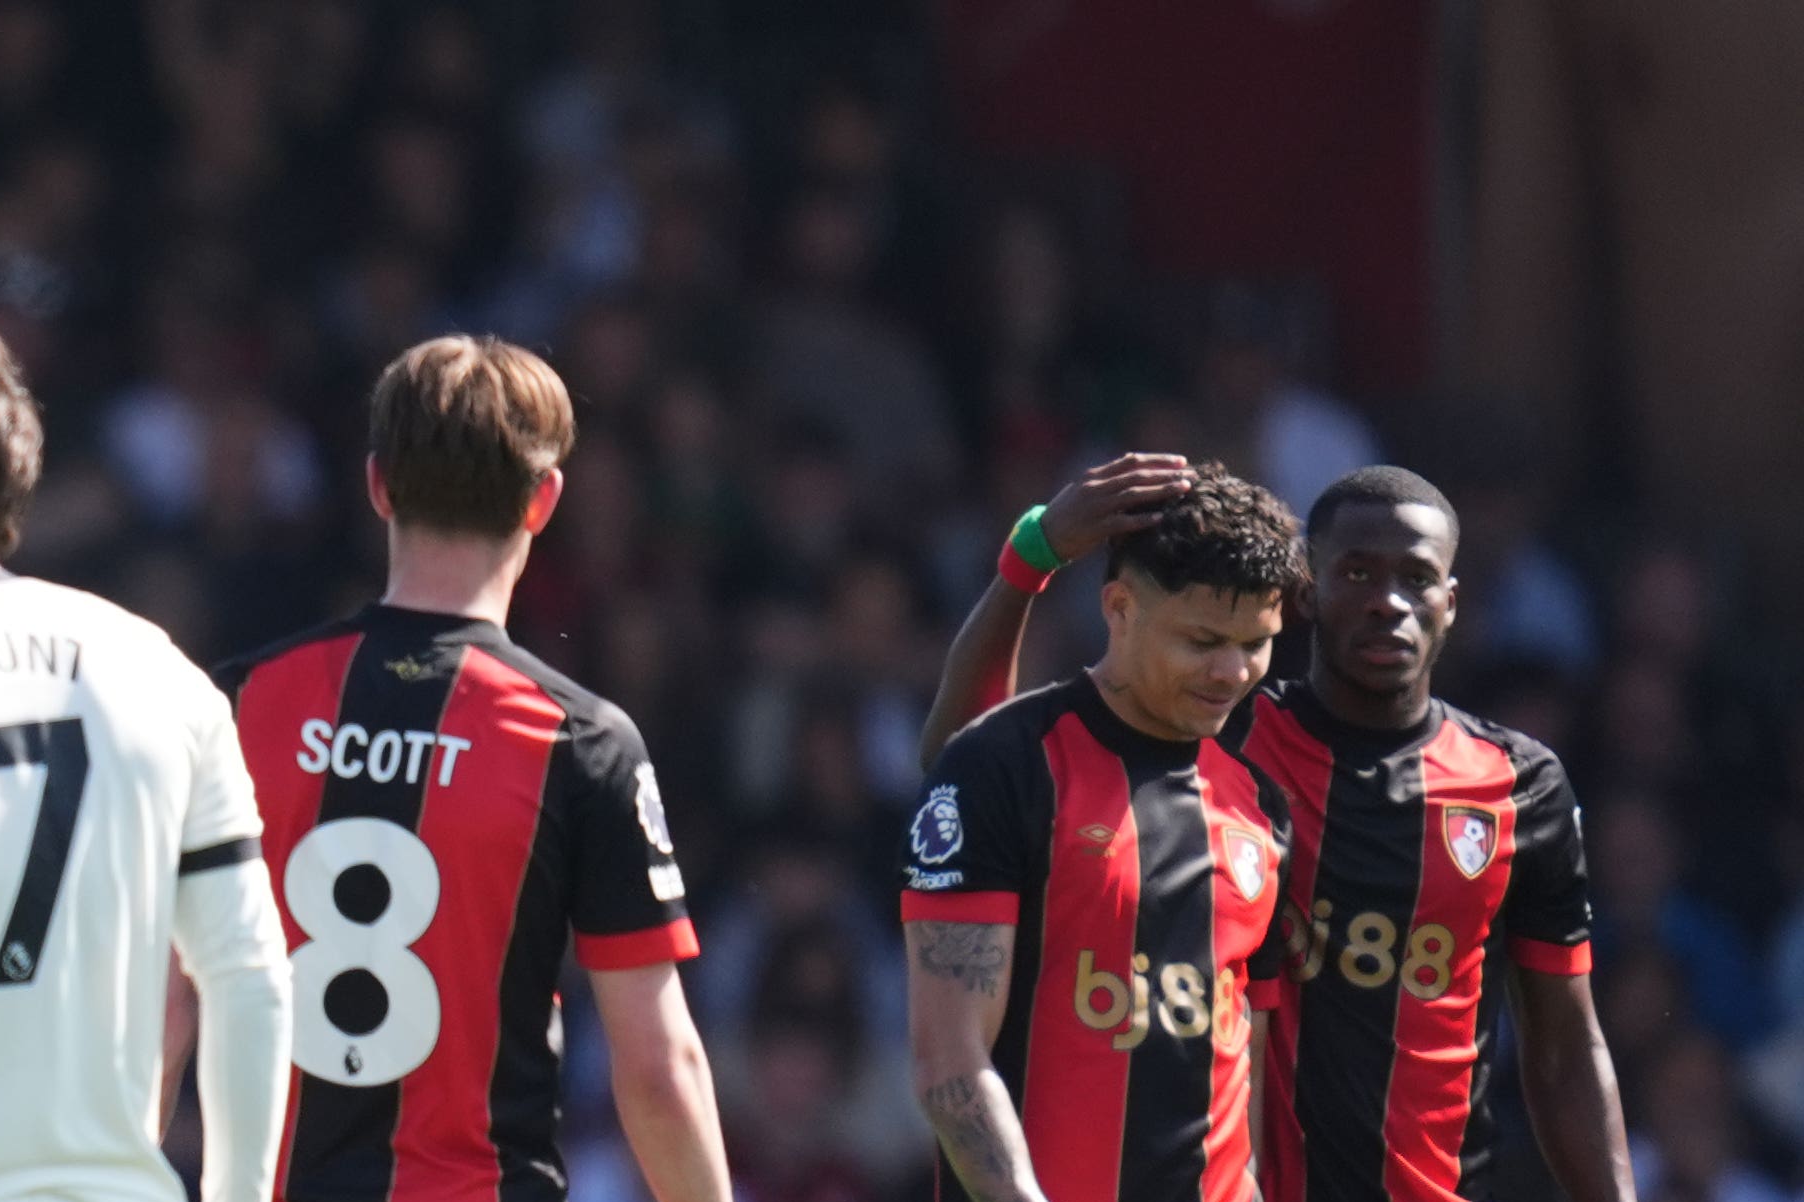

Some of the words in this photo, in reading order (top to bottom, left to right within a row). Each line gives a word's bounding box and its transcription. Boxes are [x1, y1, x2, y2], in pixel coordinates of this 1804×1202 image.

[297, 718, 472, 787] SCOTT
[284, 816, 442, 1088] 8
[1073, 949, 1235, 1052] bj88
